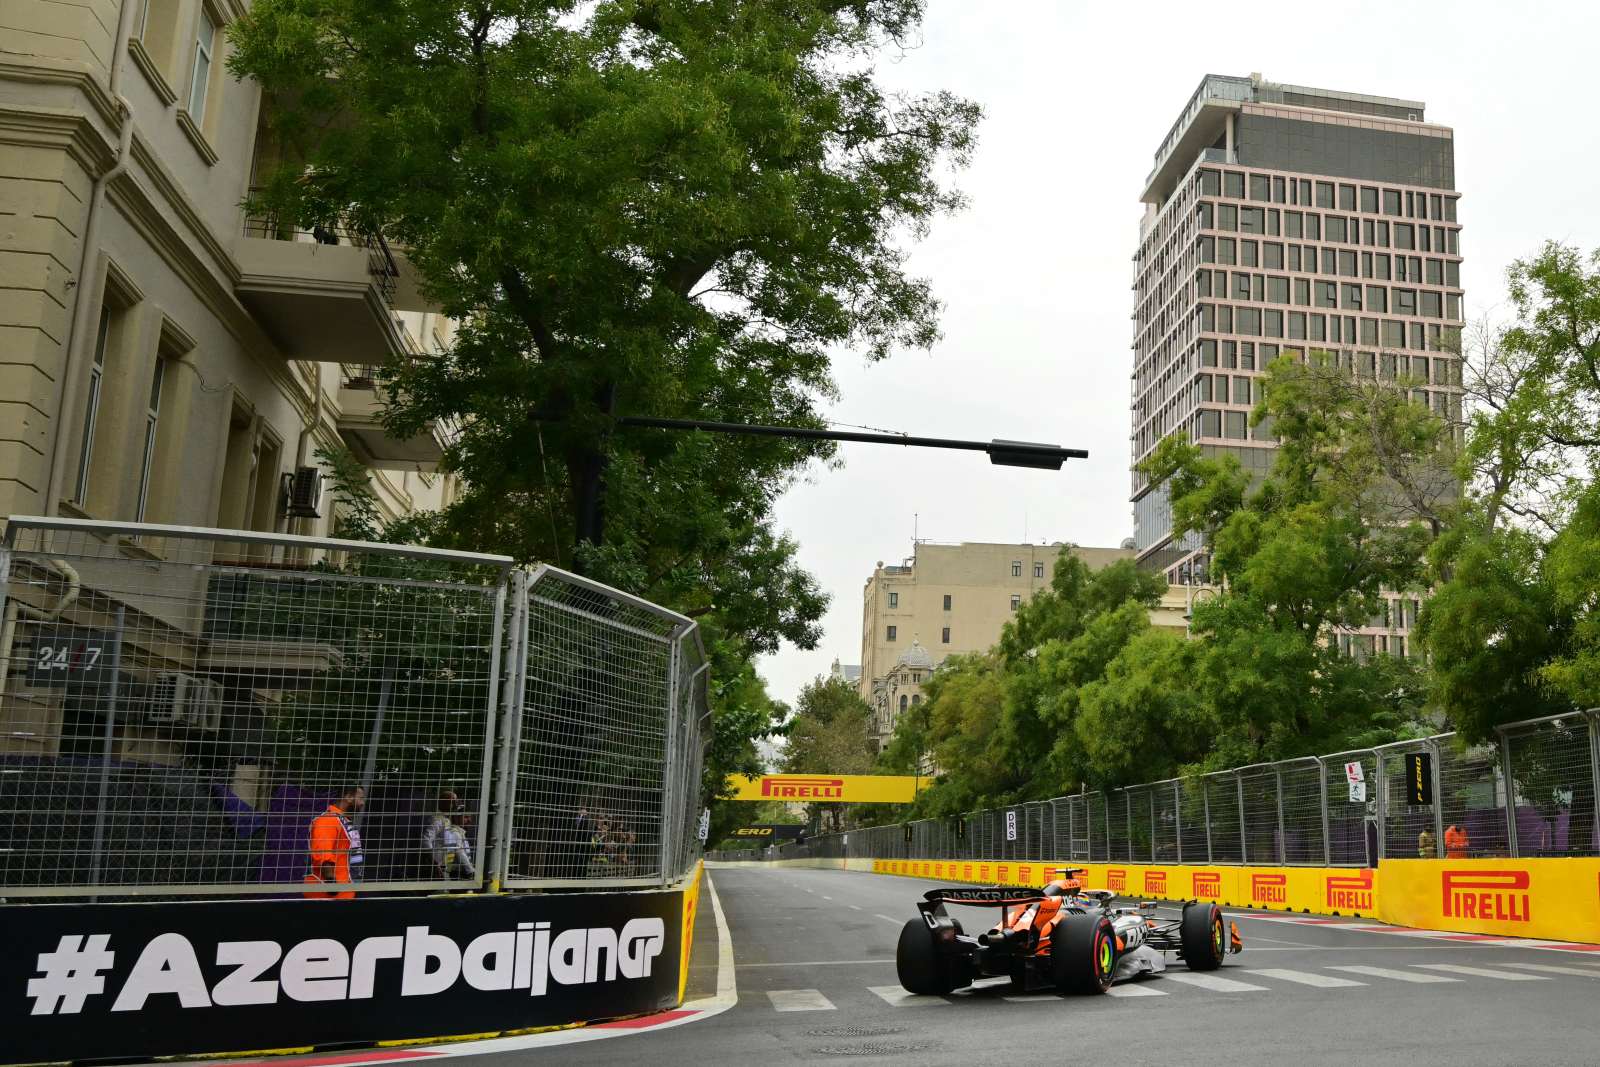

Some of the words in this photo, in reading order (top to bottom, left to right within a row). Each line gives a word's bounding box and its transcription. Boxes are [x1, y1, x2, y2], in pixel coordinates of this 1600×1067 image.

[37, 643, 102, 672] 24/7
[761, 778, 844, 798] PIRELLI
[730, 828, 773, 836] ERO
[1145, 871, 1167, 894] PIRELLI
[1193, 872, 1221, 899] PIRELLI
[1252, 874, 1287, 904] PIRELLI
[1326, 876, 1373, 910] PIRELLI
[1441, 870, 1531, 922] PIRELLI
